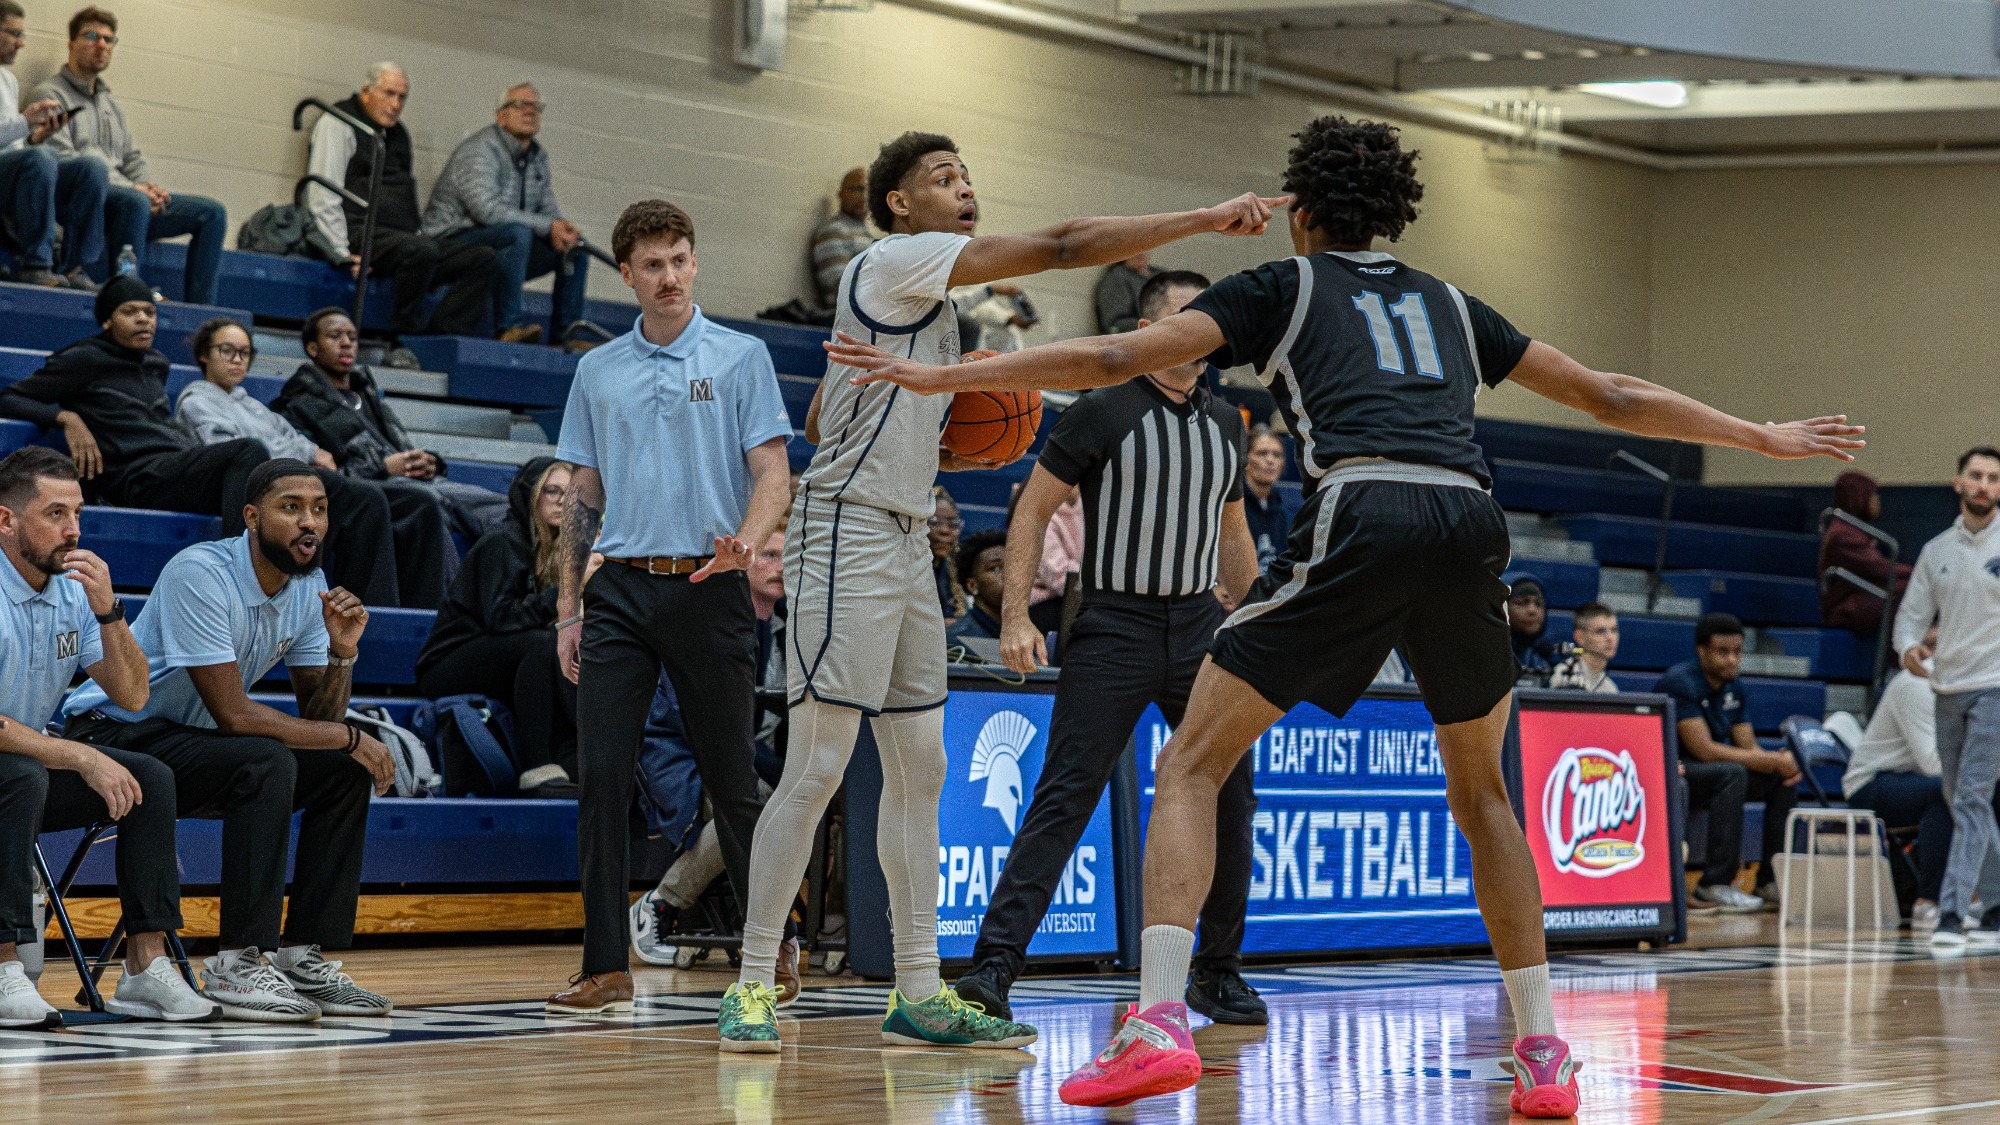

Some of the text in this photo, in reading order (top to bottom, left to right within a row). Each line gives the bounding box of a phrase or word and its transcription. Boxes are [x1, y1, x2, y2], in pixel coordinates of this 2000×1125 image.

[1352, 290, 1443, 379] 11
[690, 377, 714, 402] M
[56, 630, 79, 660] M
[1269, 726, 1361, 775] BAPTIST
[1368, 729, 1446, 776] UNIVER
[1250, 810, 1470, 899] SKETBALL
[936, 914, 977, 936] issouri
[1037, 912, 1096, 933] IVERSITY
